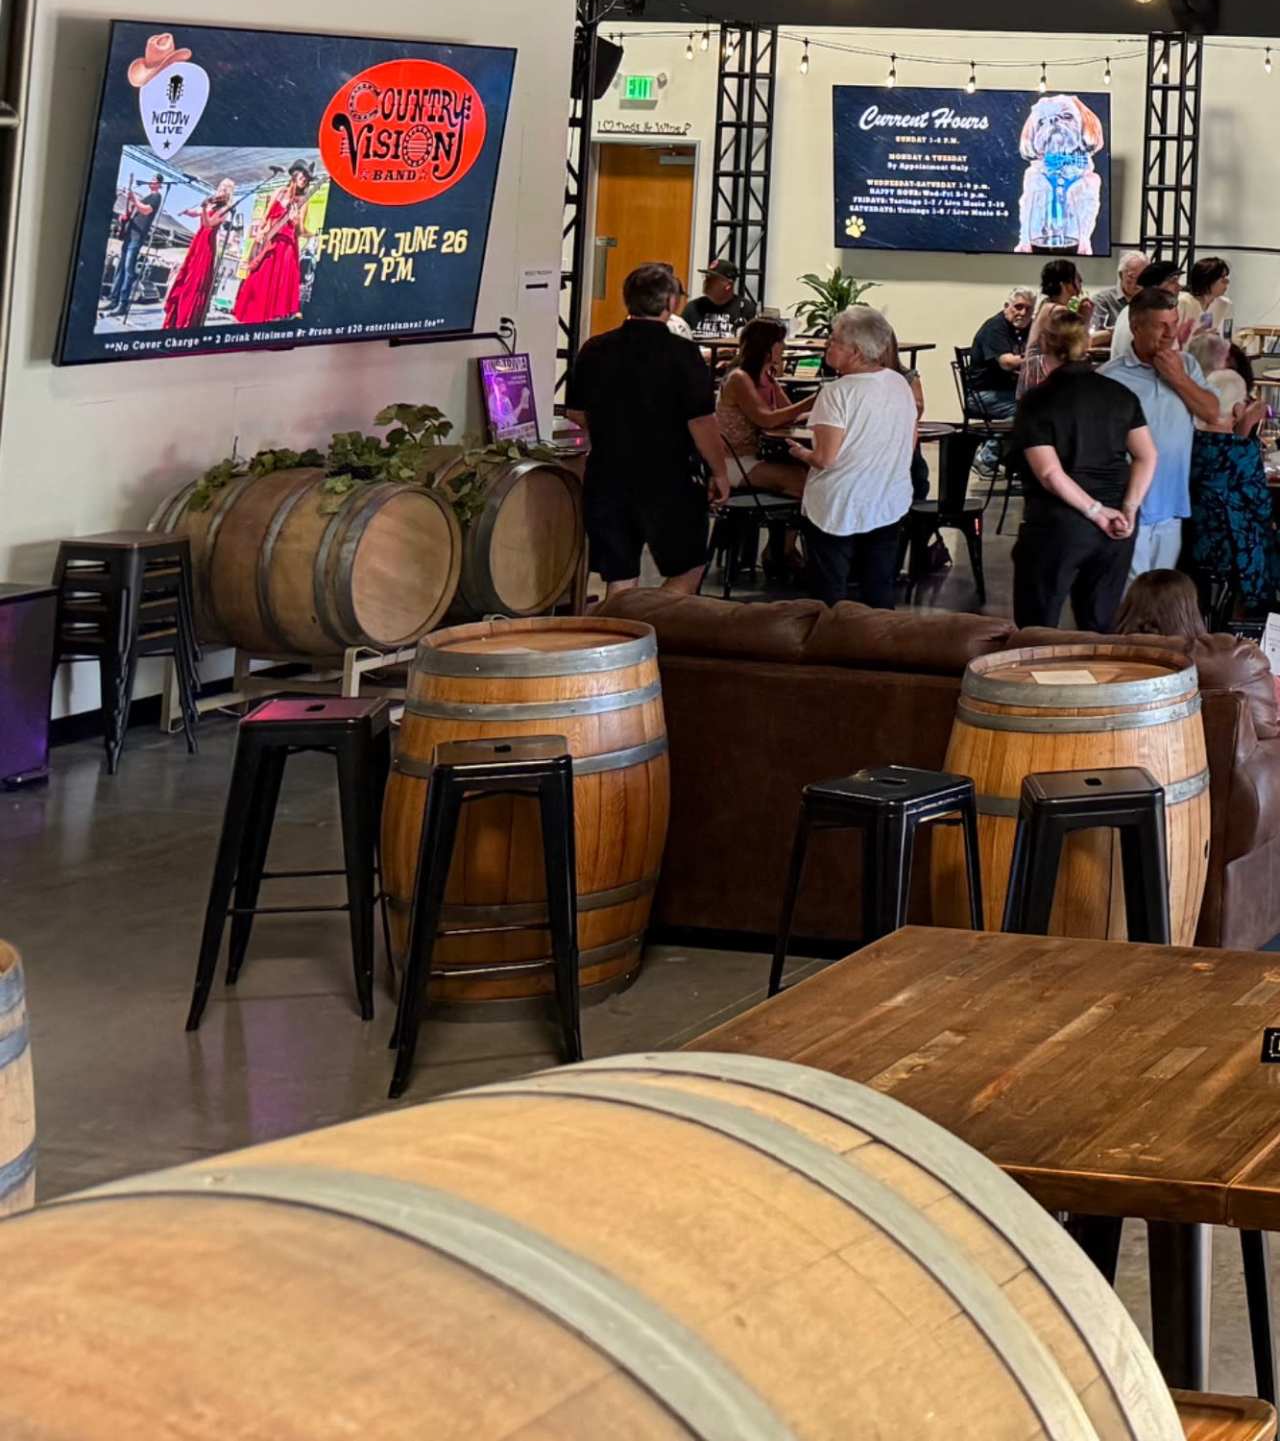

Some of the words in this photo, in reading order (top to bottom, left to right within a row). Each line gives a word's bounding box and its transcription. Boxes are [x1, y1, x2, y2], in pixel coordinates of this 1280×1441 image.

[349, 80, 473, 129] COUNTRY
[858, 105, 929, 131] Current
[931, 107, 990, 130] Hours
[155, 125, 183, 135] LIVE
[331, 112, 455, 177] VISION
[895, 136, 928, 144] SUNDAY
[888, 153, 922, 161] MONDAY
[932, 154, 968, 162] TUESDAY
[887, 162, 897, 170] By
[899, 162, 948, 172] Appointment
[950, 164, 968, 173] Only
[371, 169, 417, 181] BAND
[866, 179, 956, 189] WEDNESDAY-SATURDAY
[889, 197, 922, 206] Tastings
[897, 206, 929, 215] Tastings
[952, 208, 969, 216] Live
[971, 208, 994, 217] Music
[316, 226, 385, 261] FRIDAY,
[390, 225, 440, 258] JUNE
[440, 228, 469, 254] 26
[363, 263, 377, 287] 7
[381, 257, 416, 283] P.M.
[132, 340, 162, 351] Cover
[164, 337, 199, 349] Charge
[224, 332, 250, 343] Drink
[252, 328, 294, 341] Minimum
[365, 321, 422, 332] entertainment
